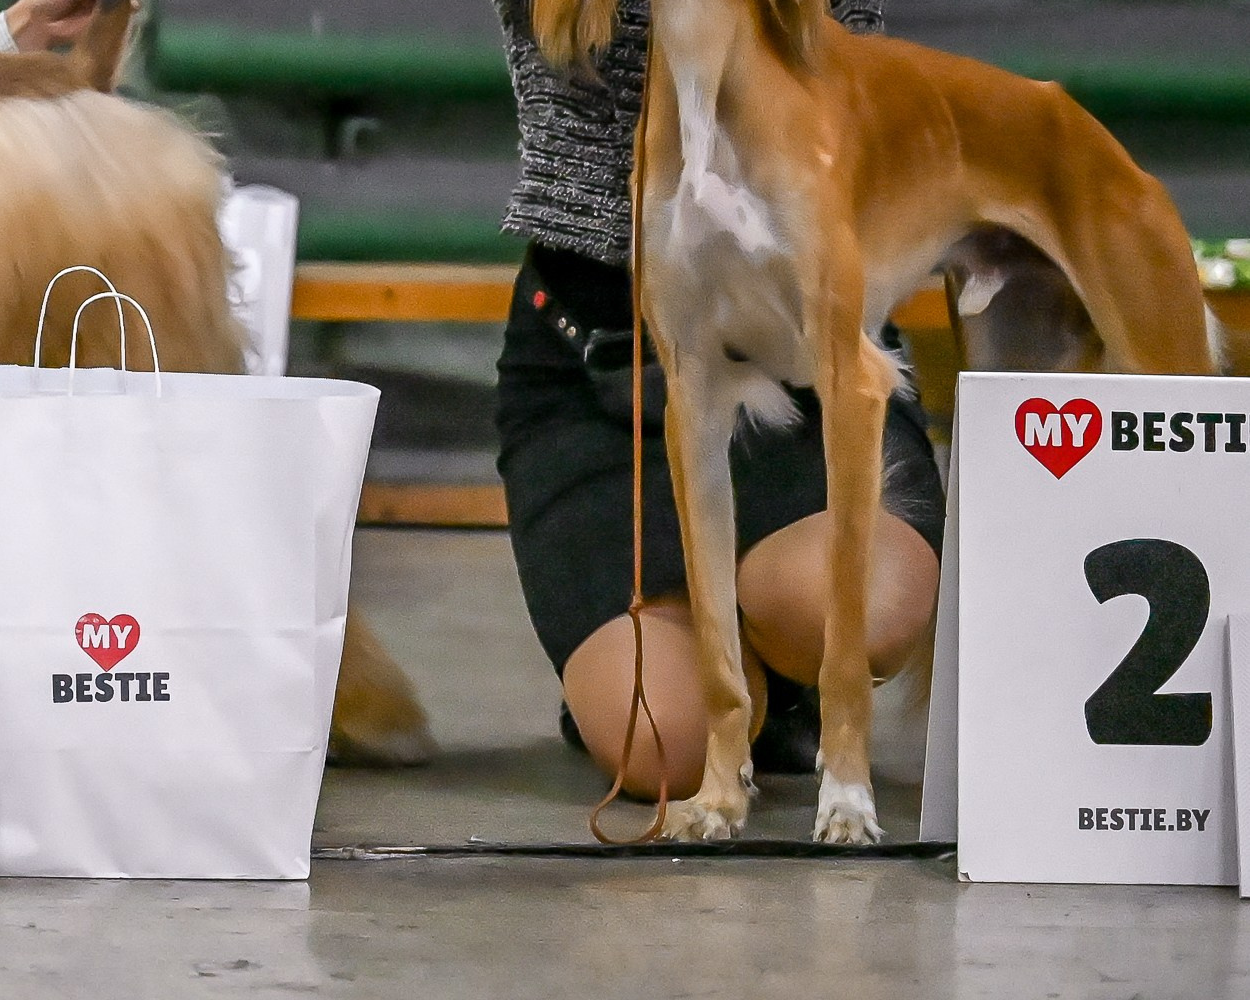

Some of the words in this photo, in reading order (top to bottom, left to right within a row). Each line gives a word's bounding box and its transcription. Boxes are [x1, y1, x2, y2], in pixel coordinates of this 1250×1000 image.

[1024, 412, 1093, 447] MY
[1111, 410, 1250, 454] BESTI
[82, 623, 134, 649] MY
[1083, 538, 1213, 746] 2
[51, 671, 171, 704] BESTIE
[1078, 806, 1211, 832] BESTIE.BY
